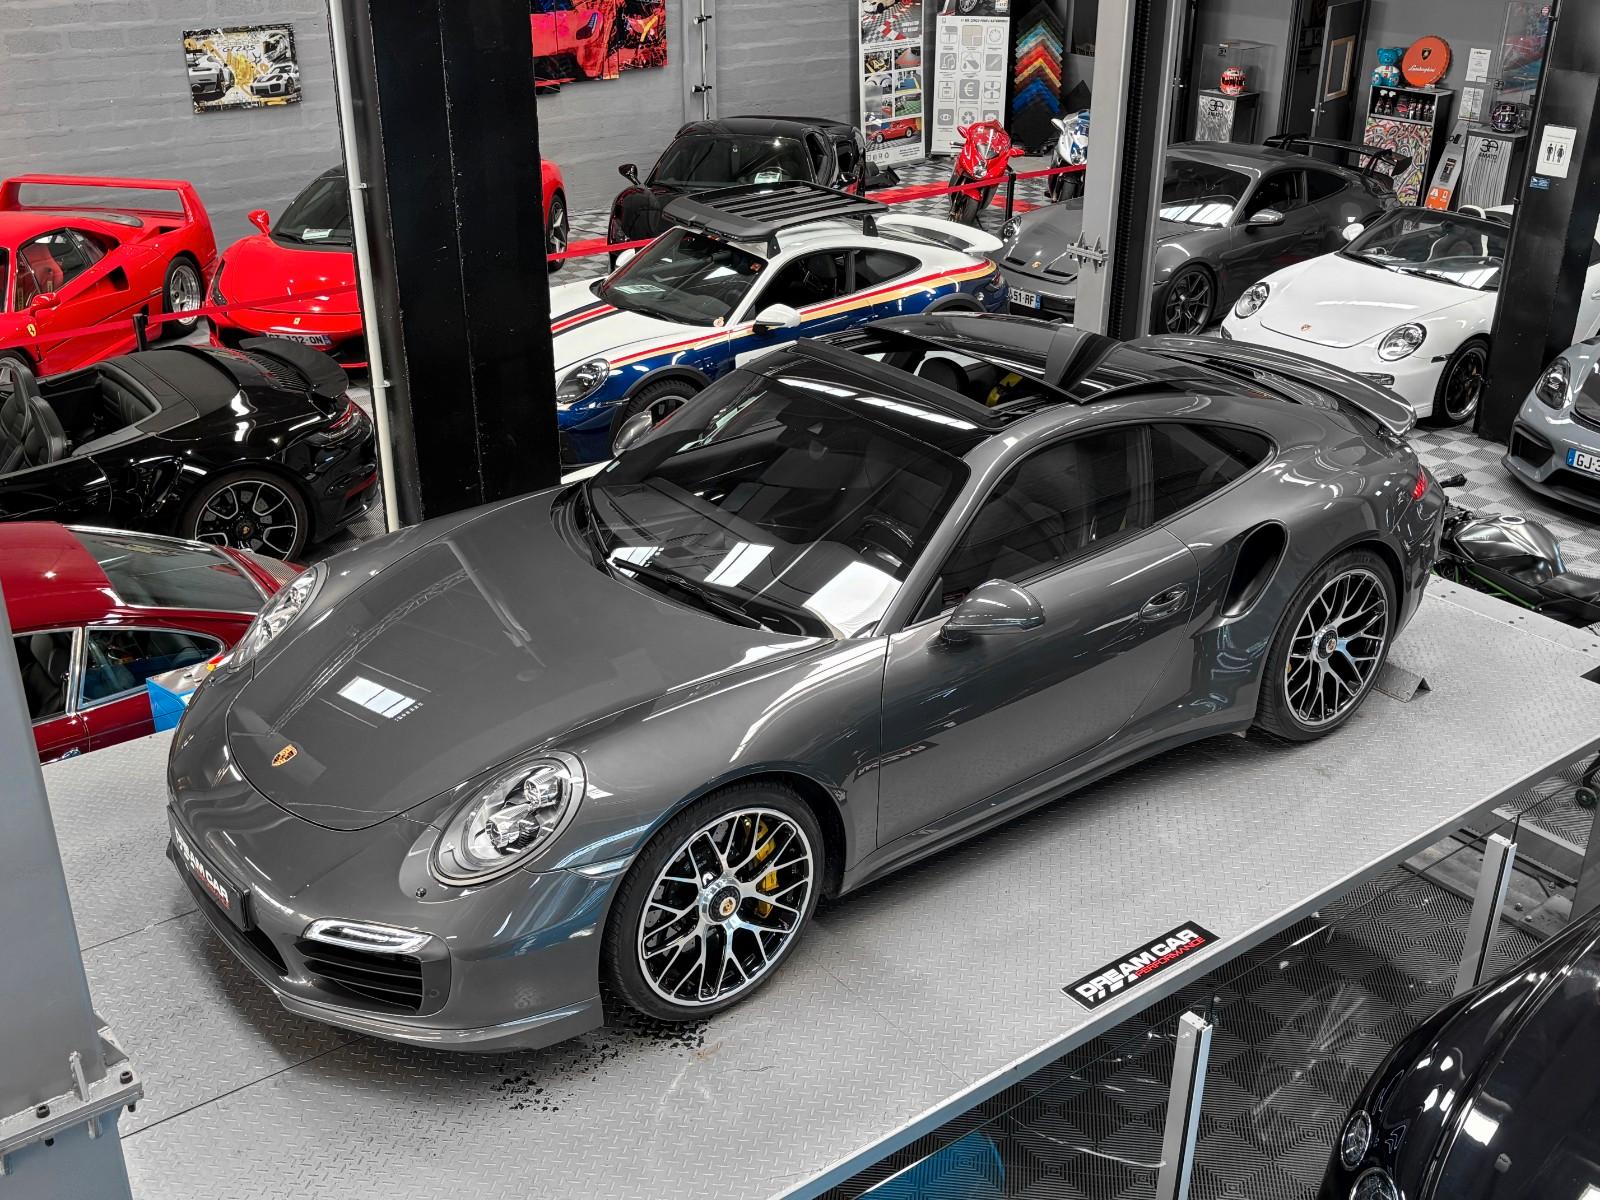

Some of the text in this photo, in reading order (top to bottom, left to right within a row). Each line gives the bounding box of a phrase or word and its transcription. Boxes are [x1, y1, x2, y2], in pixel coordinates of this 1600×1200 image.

[1478, 151, 1498, 160] AMATO
[205, 870, 230, 904] CAR
[1074, 928, 1200, 1002] DREAM CAR
[1135, 936, 1206, 978] PERFORMANCE
